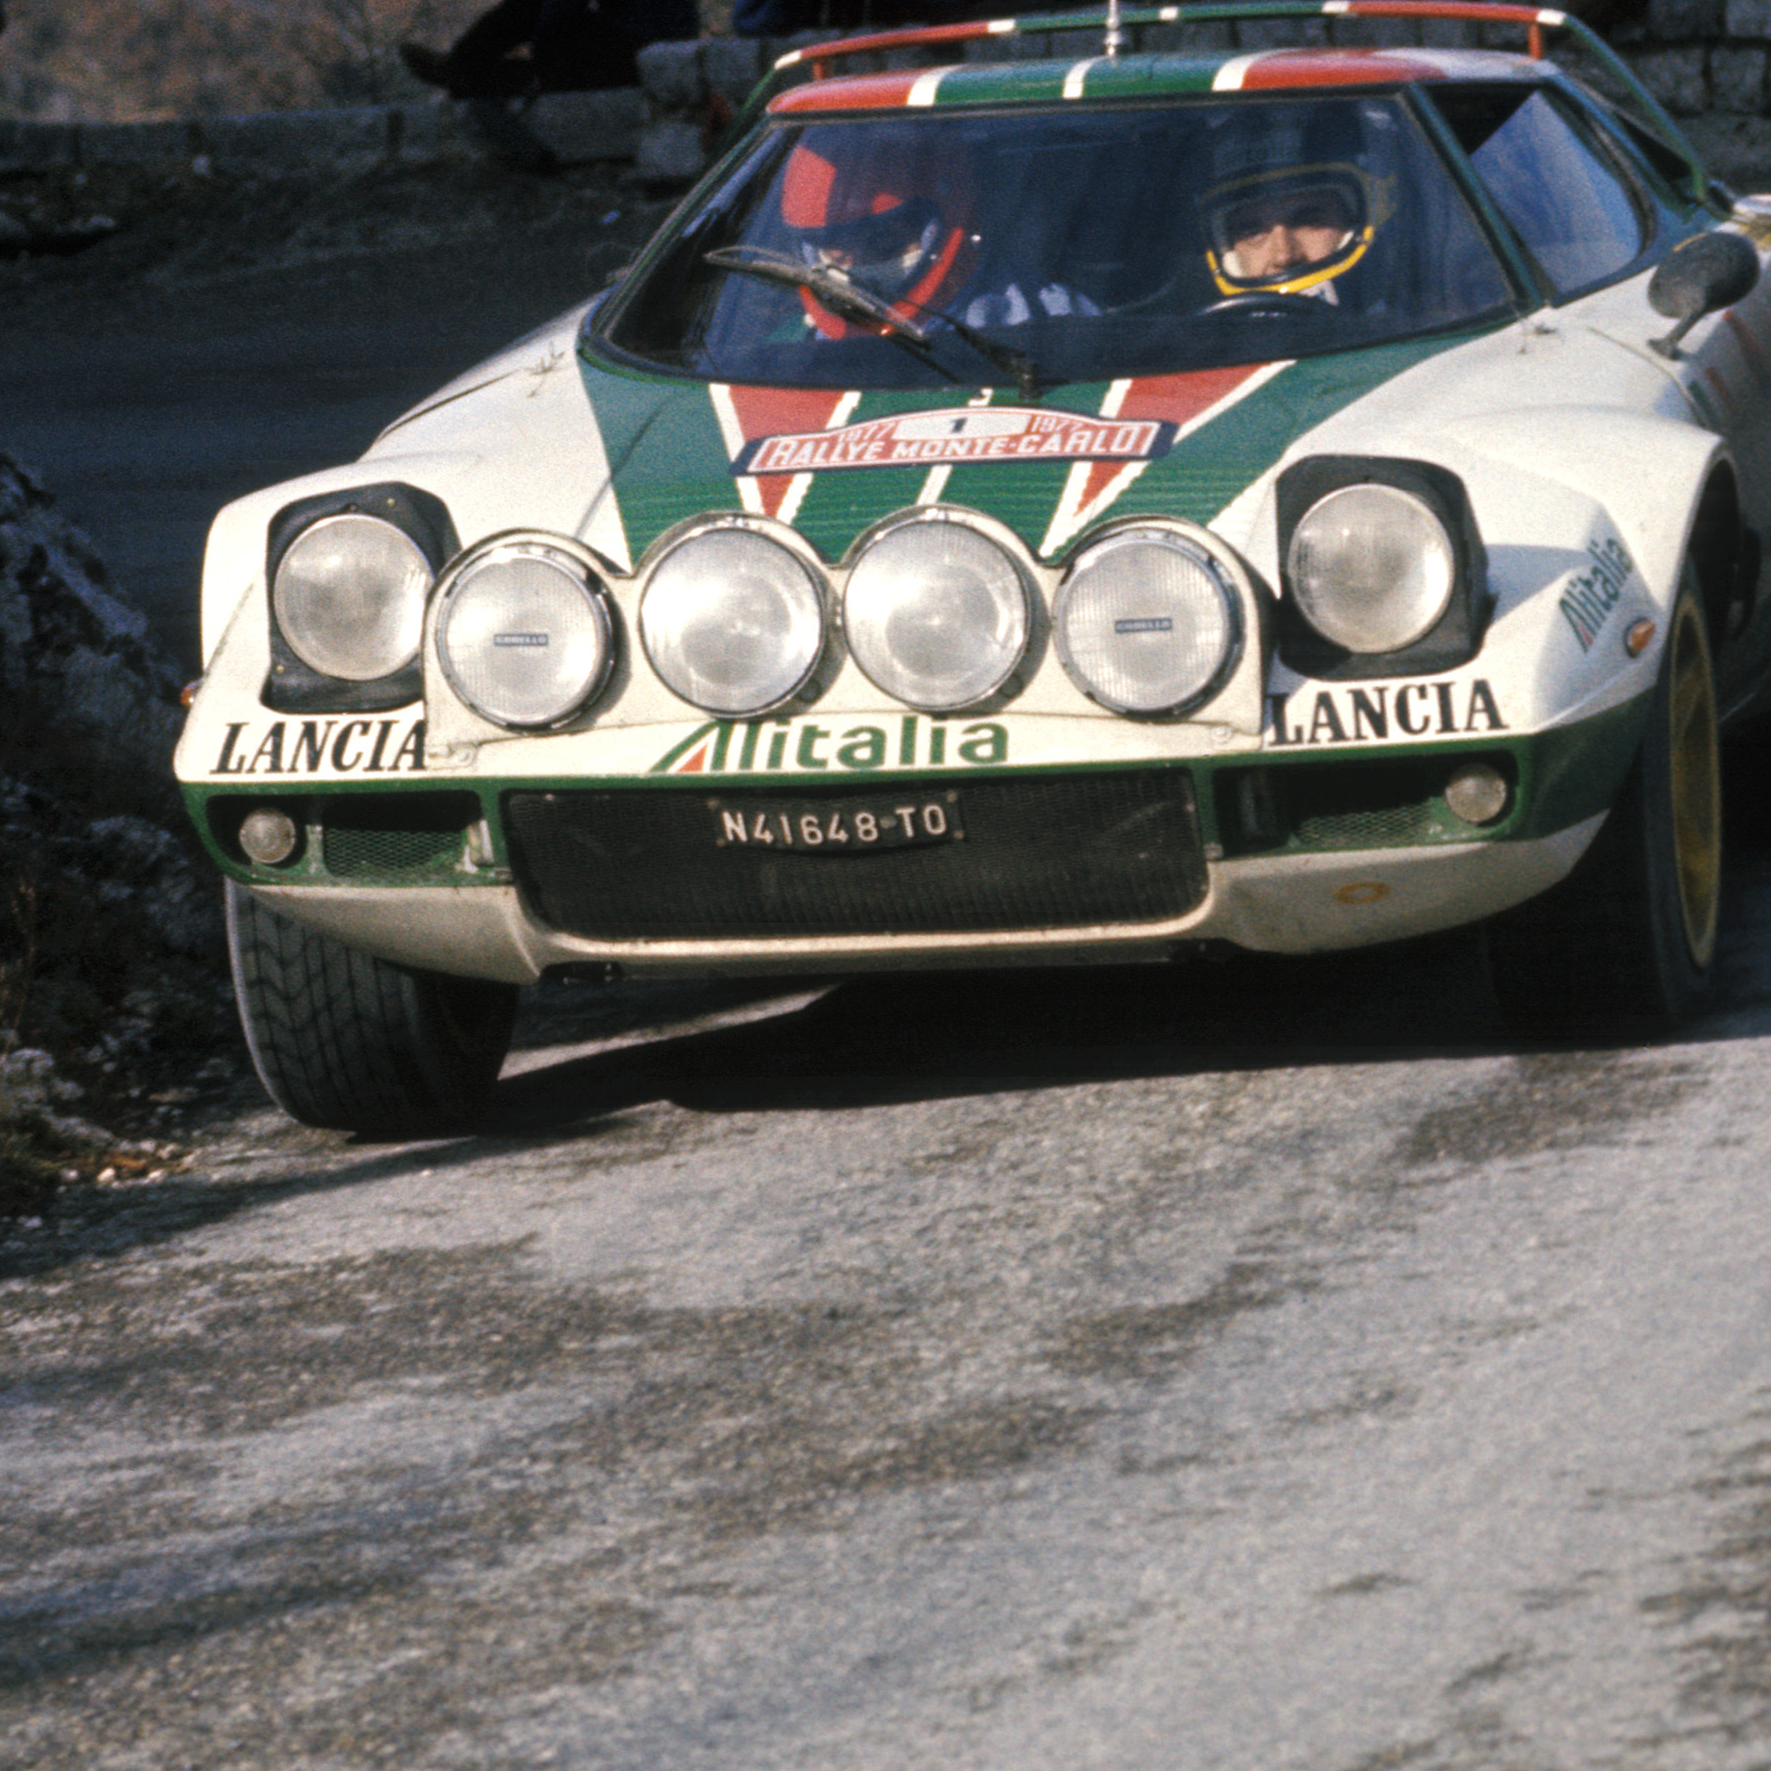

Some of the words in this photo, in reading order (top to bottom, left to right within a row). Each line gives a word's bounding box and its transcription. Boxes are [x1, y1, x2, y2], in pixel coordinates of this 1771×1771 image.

[766, 439, 886, 467] RALLYE
[890, 424, 1142, 460] MONTE-CARLO
[950, 417, 968, 433] 1
[1030, 415, 1085, 434] 1977
[1559, 537, 1633, 653] Alitalia
[1264, 678, 1511, 746] LANCIA
[208, 719, 428, 774] LANCIA
[648, 715, 1009, 773] Alitalia
[721, 811, 879, 845] N41648
